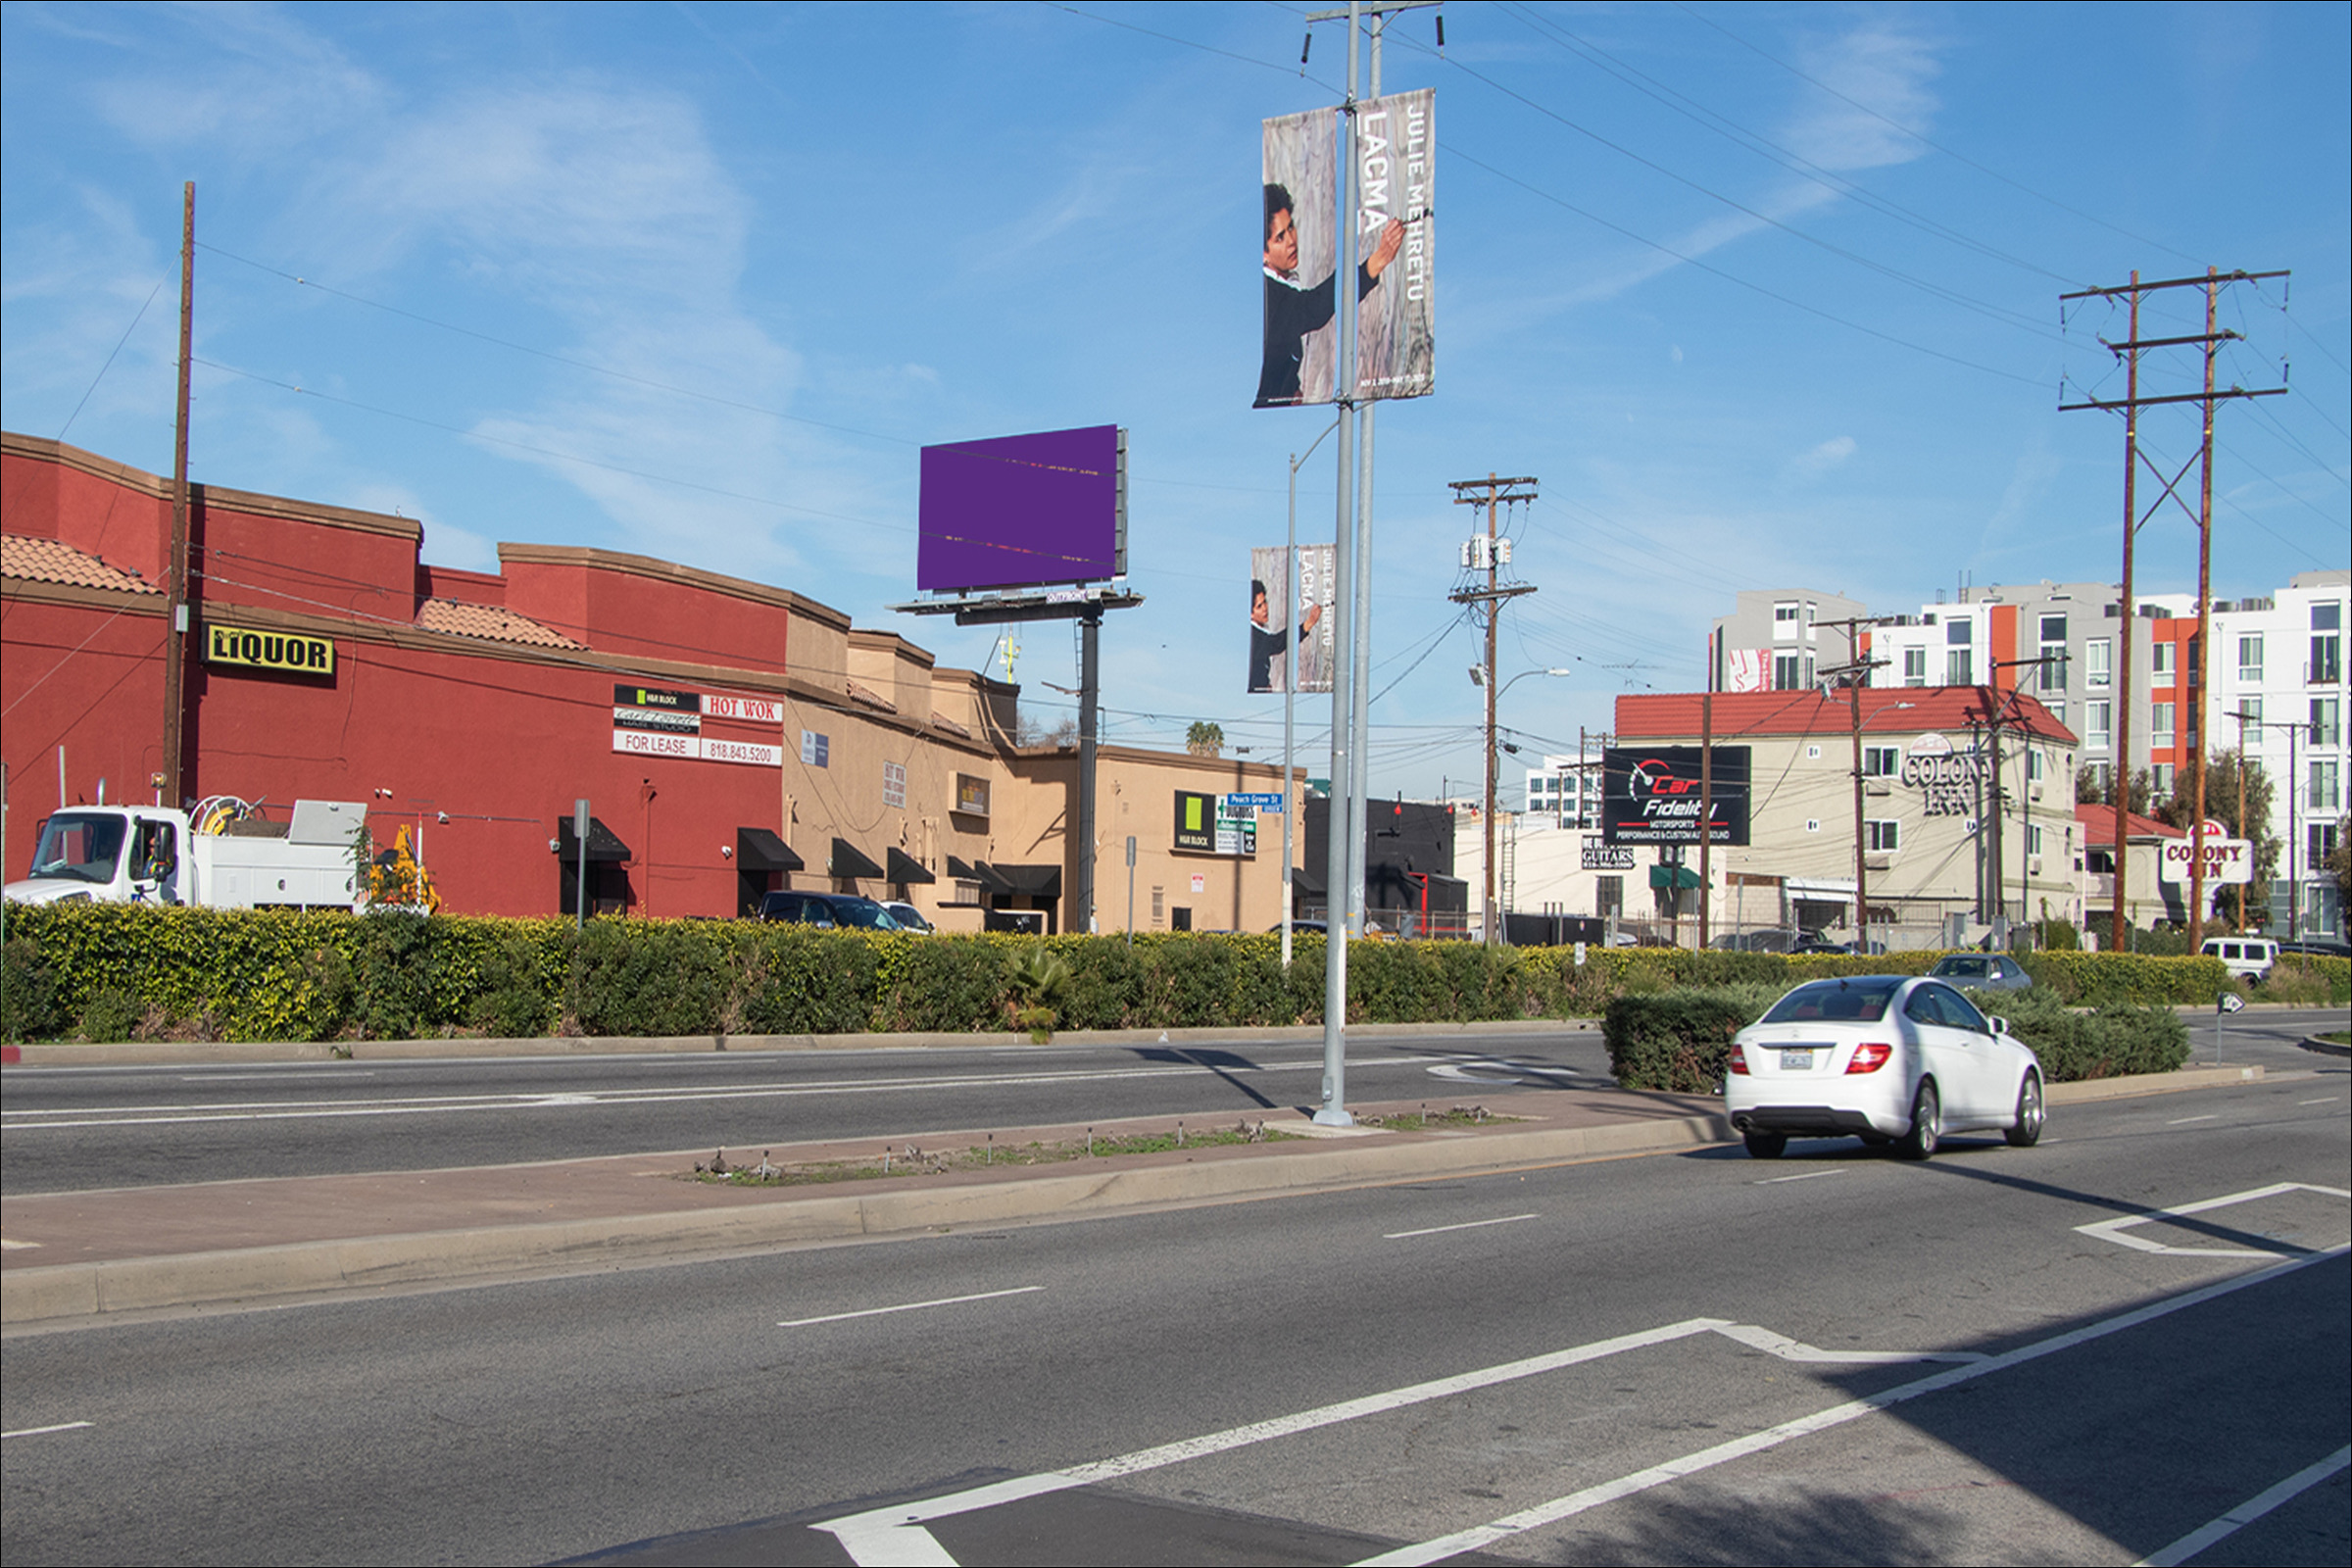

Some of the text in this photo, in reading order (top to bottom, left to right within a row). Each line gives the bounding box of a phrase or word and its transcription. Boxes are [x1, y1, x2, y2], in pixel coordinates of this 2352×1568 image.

[1364, 111, 1388, 234] LACMA
[1407, 104, 1424, 301] JULIE MEHRETU
[1323, 549, 1333, 586] JULIE
[1301, 551, 1315, 611] LACMA
[214, 629, 327, 668] LIQUOR
[660, 695, 677, 705] BLOCK
[710, 697, 775, 719] HOT WOK
[625, 735, 687, 754] FOR LEASE
[710, 742, 772, 762] 818.843.5200
[1651, 774, 1699, 794] Car
[1250, 795, 1270, 804] Grove
[1270, 795, 1279, 804] St
[1649, 819, 1695, 829] MOTORSPORTS
[1191, 835, 1209, 846] BLOCK
[1616, 830, 1660, 840] PERFORMANCE
[1666, 830, 1691, 840] CUSTOM
[1583, 850, 1634, 862] GUITARS
[2167, 845, 2243, 861] COONY
